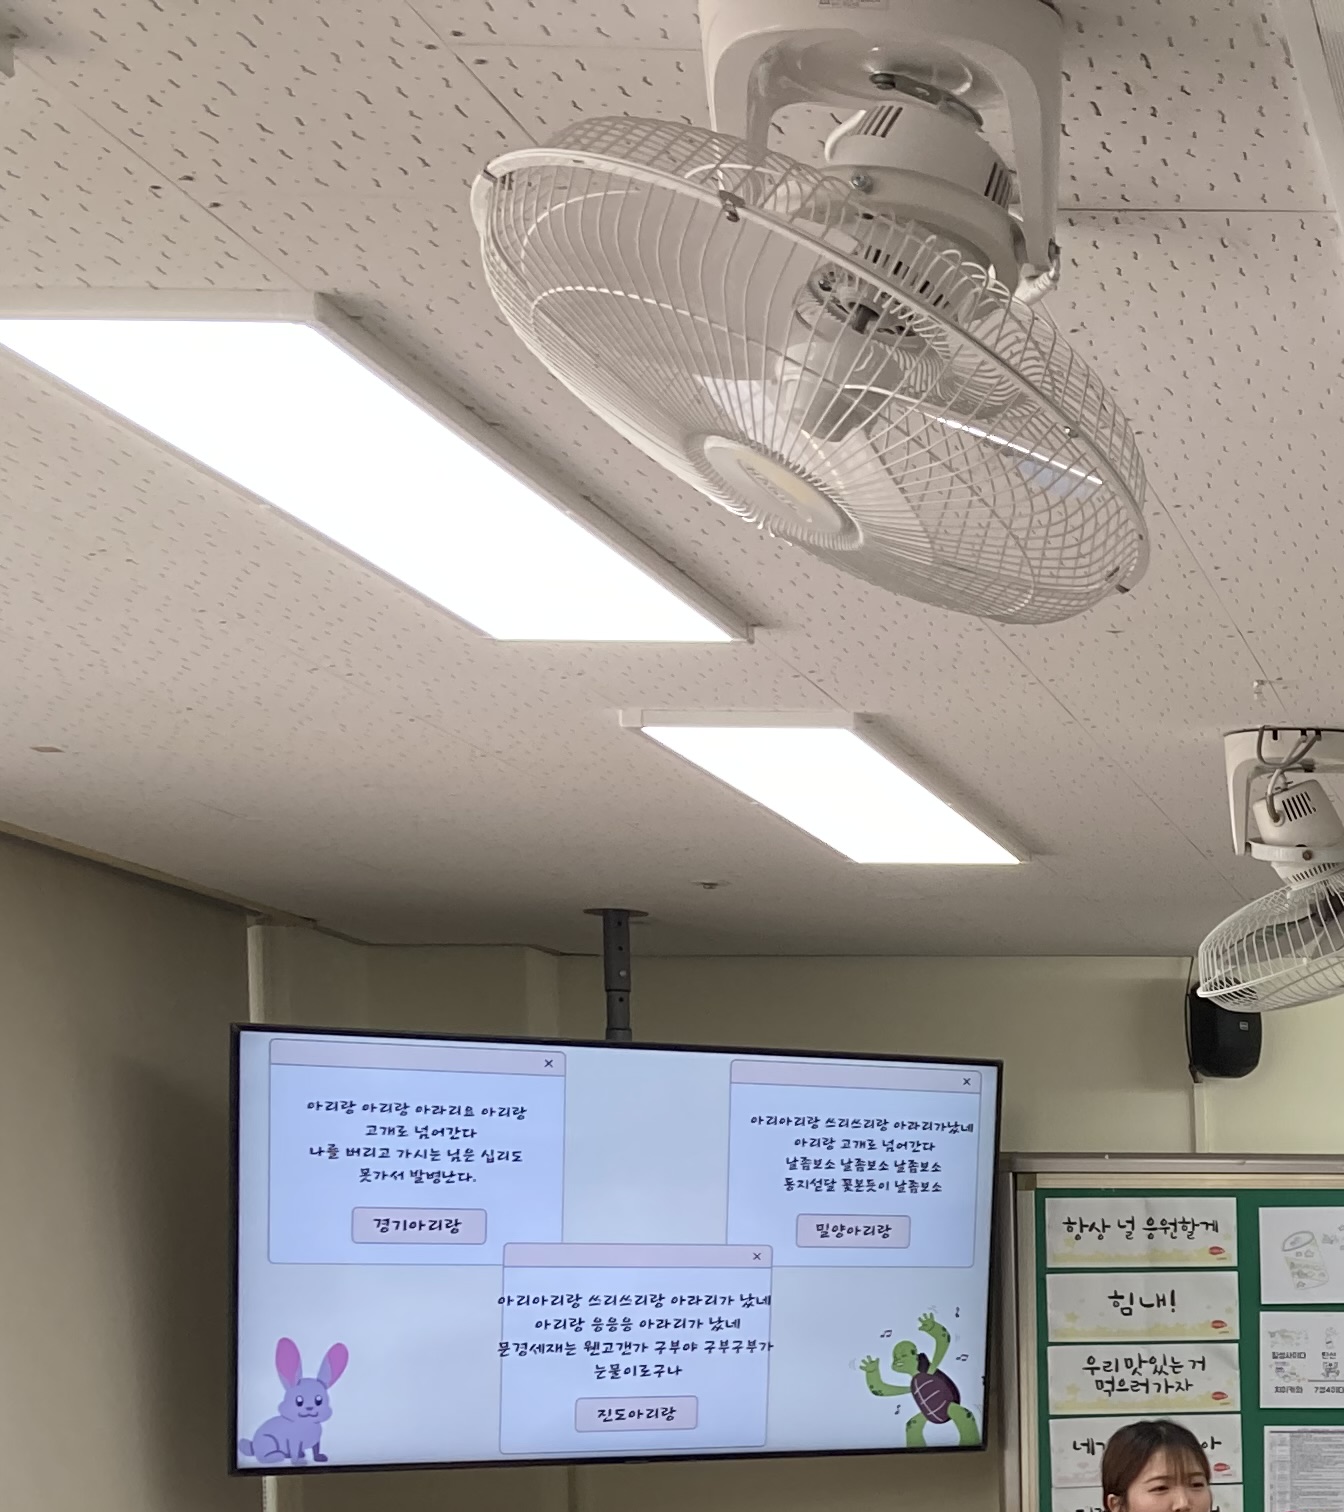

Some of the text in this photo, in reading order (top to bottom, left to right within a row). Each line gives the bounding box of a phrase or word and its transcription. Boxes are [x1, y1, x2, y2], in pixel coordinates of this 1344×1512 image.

[307, 1100, 527, 1120] 아리랑 아리랑 아라리요 아리랑
[365, 1125, 477, 1140] 고개로 넘어간다
[750, 1116, 973, 1134] 아리아리랑 쓰리쓰리랑 아라리가났네
[794, 1137, 936, 1152] 아리랑 고개로 넘어간다
[309, 1144, 340, 1159] 나를
[346, 1147, 391, 1158] 버리고
[396, 1148, 441, 1161] 가시는
[481, 1149, 523, 1163] 십리도
[786, 1157, 942, 1173] 날좀보소 날좀보소 날좀보소
[359, 1168, 476, 1184] 못가서 발병난다.
[784, 1178, 942, 1193] 동지섣달 꽃본듯이 날좀보소
[373, 1218, 462, 1234] 경기아리랑
[816, 1223, 892, 1238] 밀양아리랑
[1062, 1216, 1219, 1240] 항상 널 응원할게
[498, 1293, 771, 1309] 아리아리랑 쓰리쓰리랑 아라리가 났네
[535, 1317, 740, 1332] 아리랑 응응응 아라리가 났네
[497, 1341, 577, 1356] 문경세재는
[654, 1341, 698, 1354] 구부야
[704, 1340, 774, 1354] 구부구부가
[594, 1364, 683, 1380] 눈물이로구나
[1082, 1353, 1205, 1376] 우리 맛있는 거
[1095, 1376, 1193, 1397] 먹으러 가자
[597, 1407, 677, 1422] 진도아리랑
